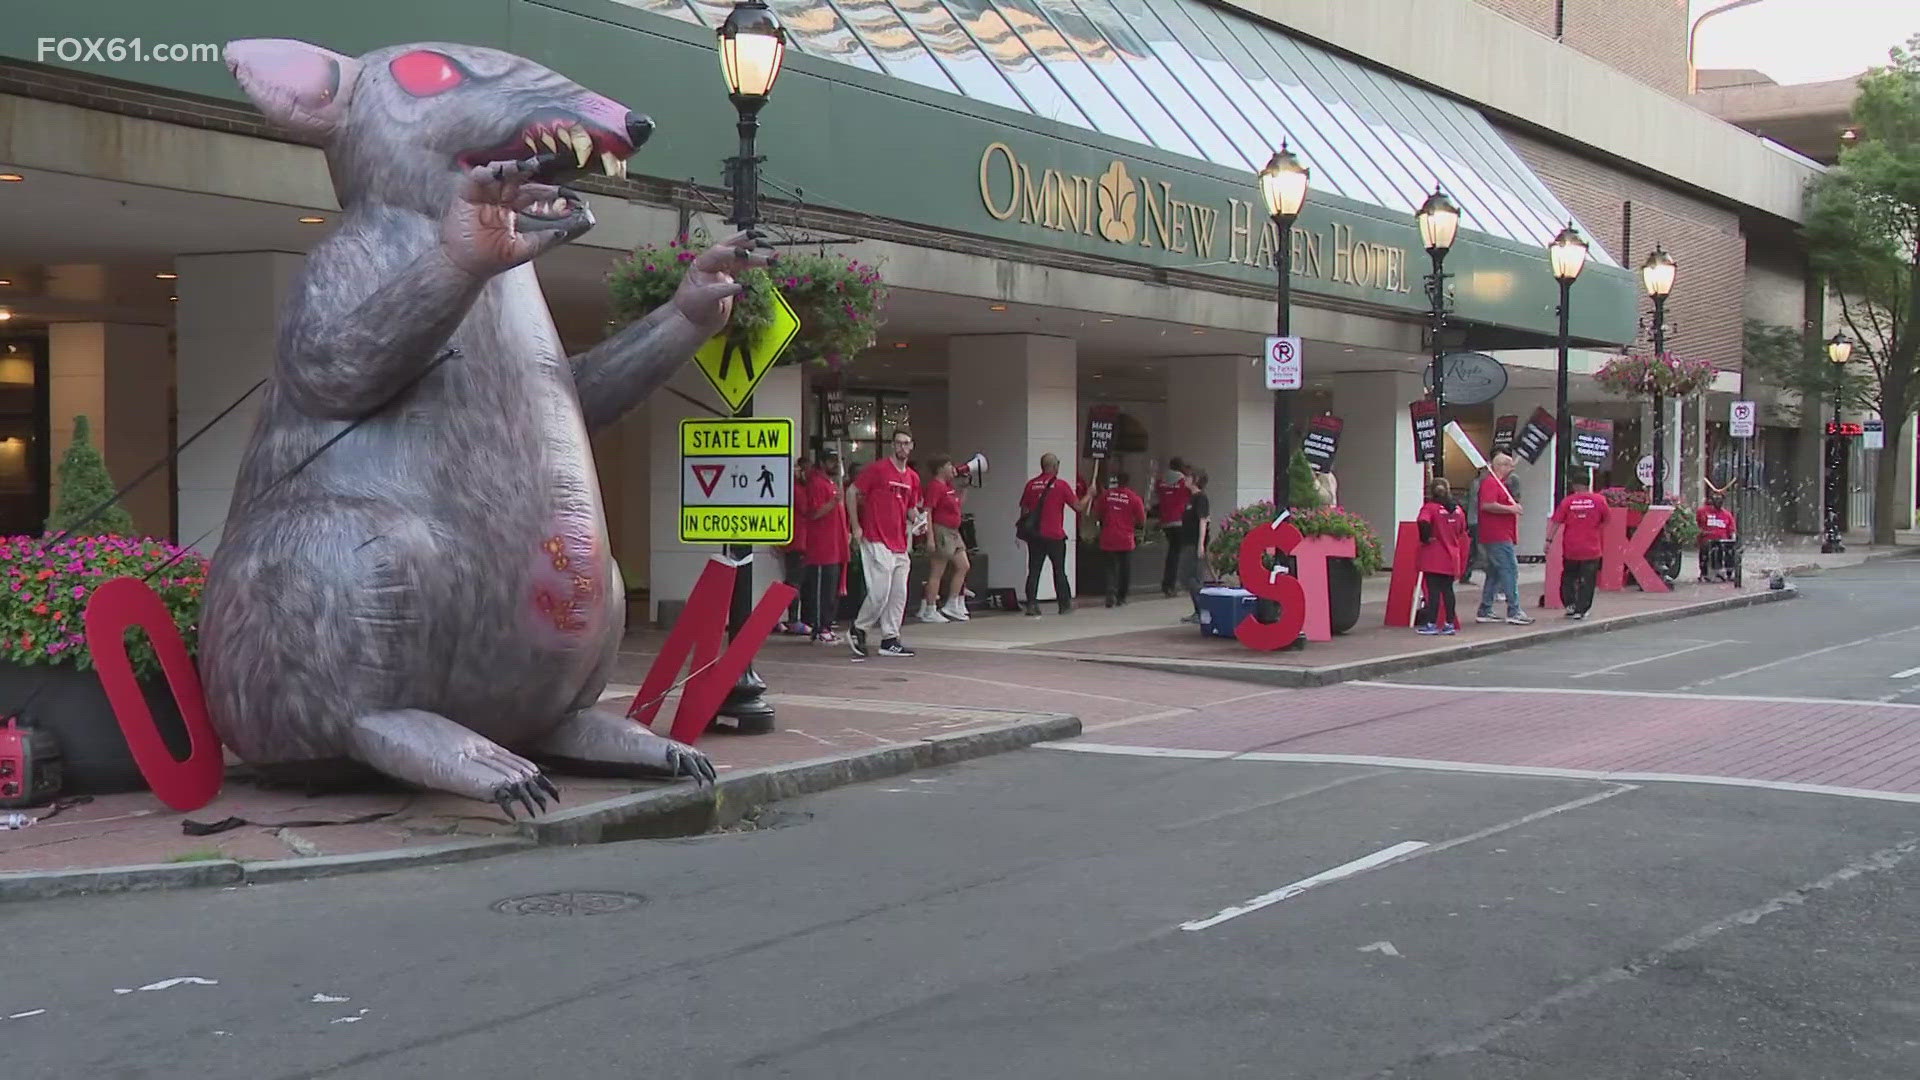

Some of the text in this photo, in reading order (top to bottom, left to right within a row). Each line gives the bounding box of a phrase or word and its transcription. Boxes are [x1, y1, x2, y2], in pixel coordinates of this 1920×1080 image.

[979, 142, 1093, 236] OMNI
[1139, 177, 1219, 258] NEW
[1331, 222, 1411, 293] HOTEL
[1092, 420, 1113, 431] MAKE
[692, 429, 780, 449] STATE LAW
[1091, 431, 1112, 440] THEM
[731, 474, 748, 489] TO
[685, 514, 786, 532] IN CROSSWALK
